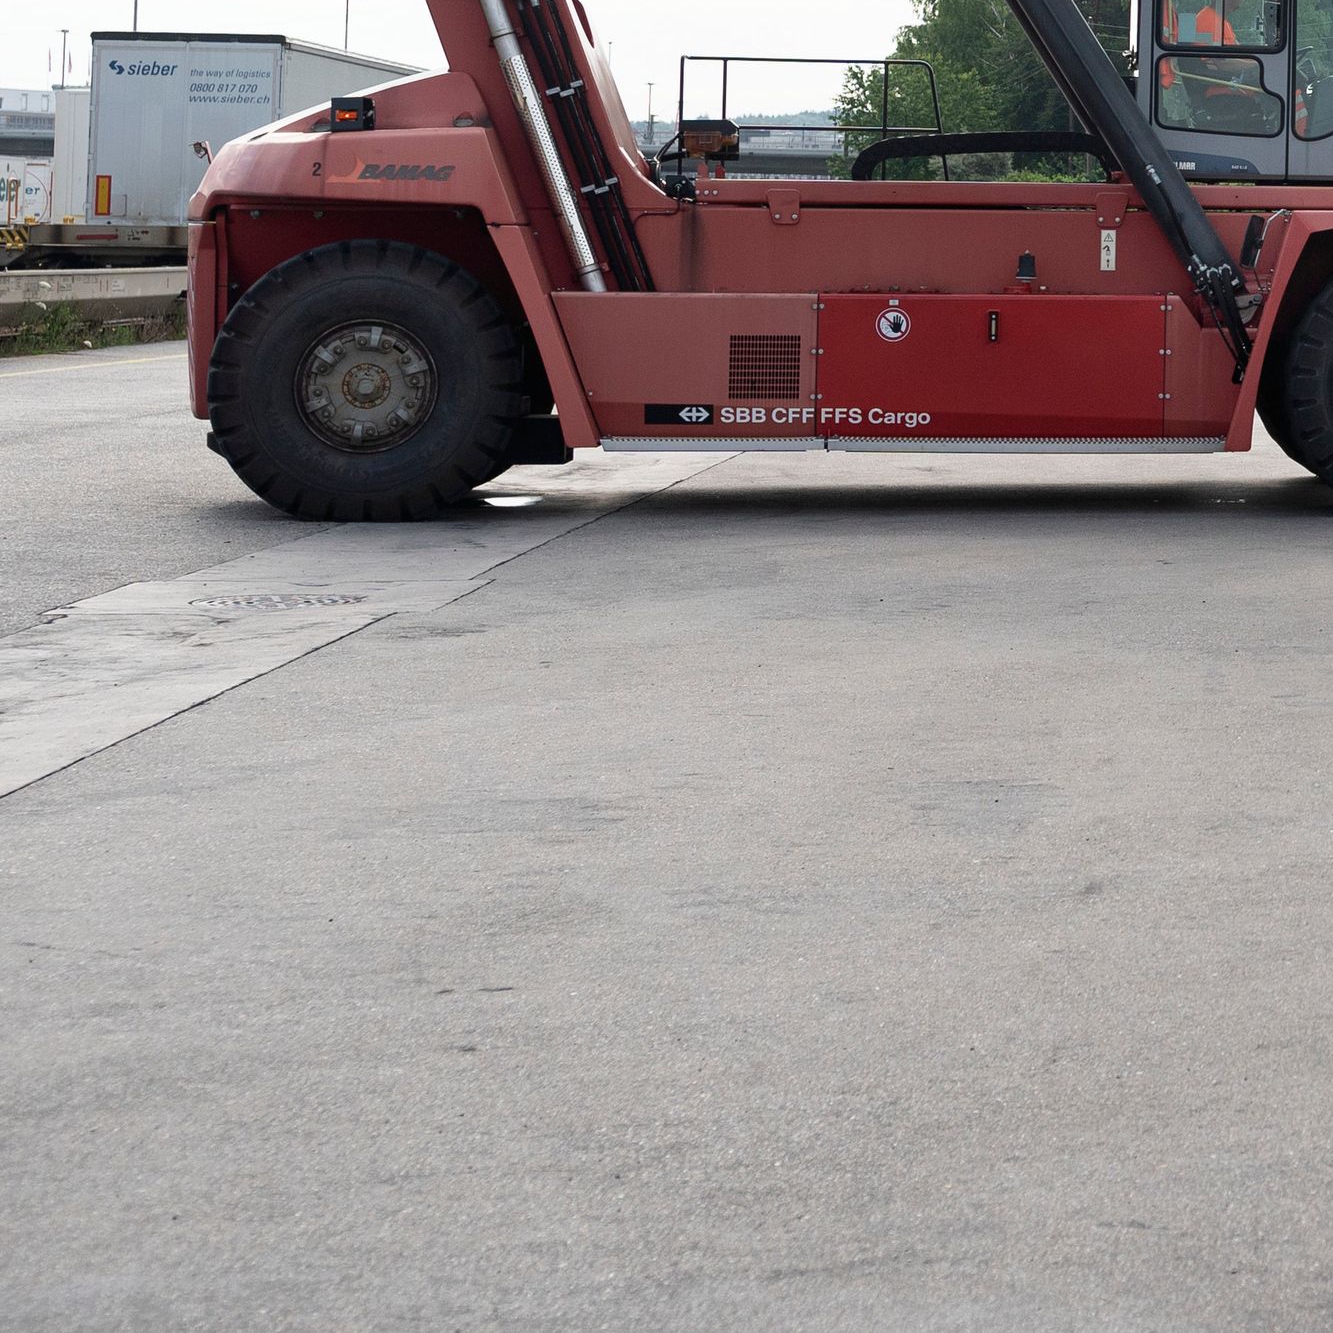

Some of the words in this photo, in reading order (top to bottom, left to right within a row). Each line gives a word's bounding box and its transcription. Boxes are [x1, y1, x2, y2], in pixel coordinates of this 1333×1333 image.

[127, 60, 179, 76] sieber
[190, 68, 204, 77] the
[205, 70, 223, 79] way
[225, 69, 234, 77] of
[235, 69, 271, 80] logistics
[189, 83, 215, 93] 0800
[217, 83, 235, 93] 817
[238, 84, 258, 94] 070
[189, 95, 270, 104] www.sieber.ch
[312, 161, 322, 177] 2
[720, 407, 766, 424] SBB
[771, 407, 815, 424] CFF
[820, 407, 862, 425] FFS
[867, 407, 932, 428] Cargo
